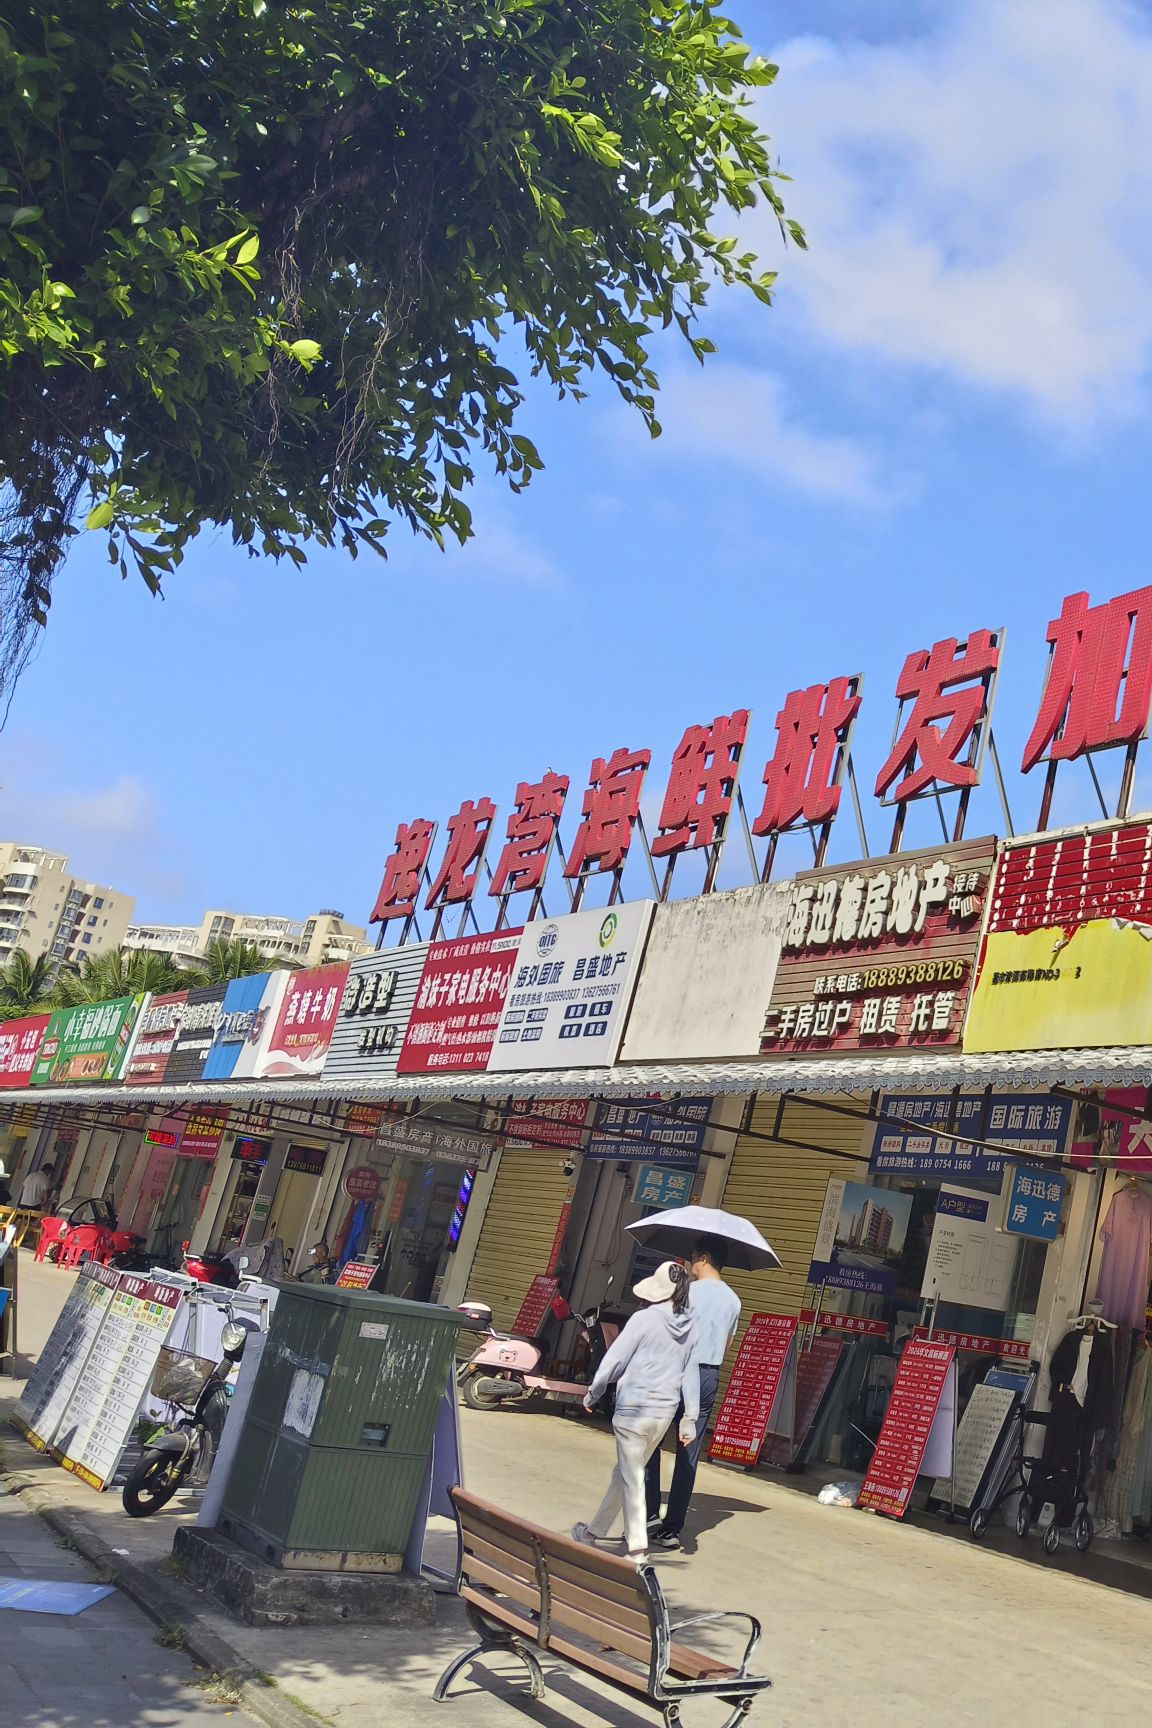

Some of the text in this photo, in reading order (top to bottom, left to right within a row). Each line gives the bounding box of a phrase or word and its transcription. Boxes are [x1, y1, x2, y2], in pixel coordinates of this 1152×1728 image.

[953, 873, 978, 893] 接待
[948, 896, 976, 918] 中心
[514, 951, 627, 988] 海外国旅 昌盛地产
[63, 1003, 125, 1042] 小幸福砂锅面
[760, 991, 955, 1038] 二手房过户 租赁 托管
[990, 1105, 1062, 1131] 国际旅游
[920, 1159, 932, 1169] 189
[934, 1159, 952, 1170] 0754
[954, 1160, 972, 1171] 1666
[987, 1161, 1001, 1171] 188
[646, 1170, 687, 1190] 昌盛
[1016, 1175, 1061, 1201] 海迅德
[640, 1186, 684, 1203] 房产
[941, 1195, 966, 1213] A户型
[1011, 1204, 1057, 1228] 房产
